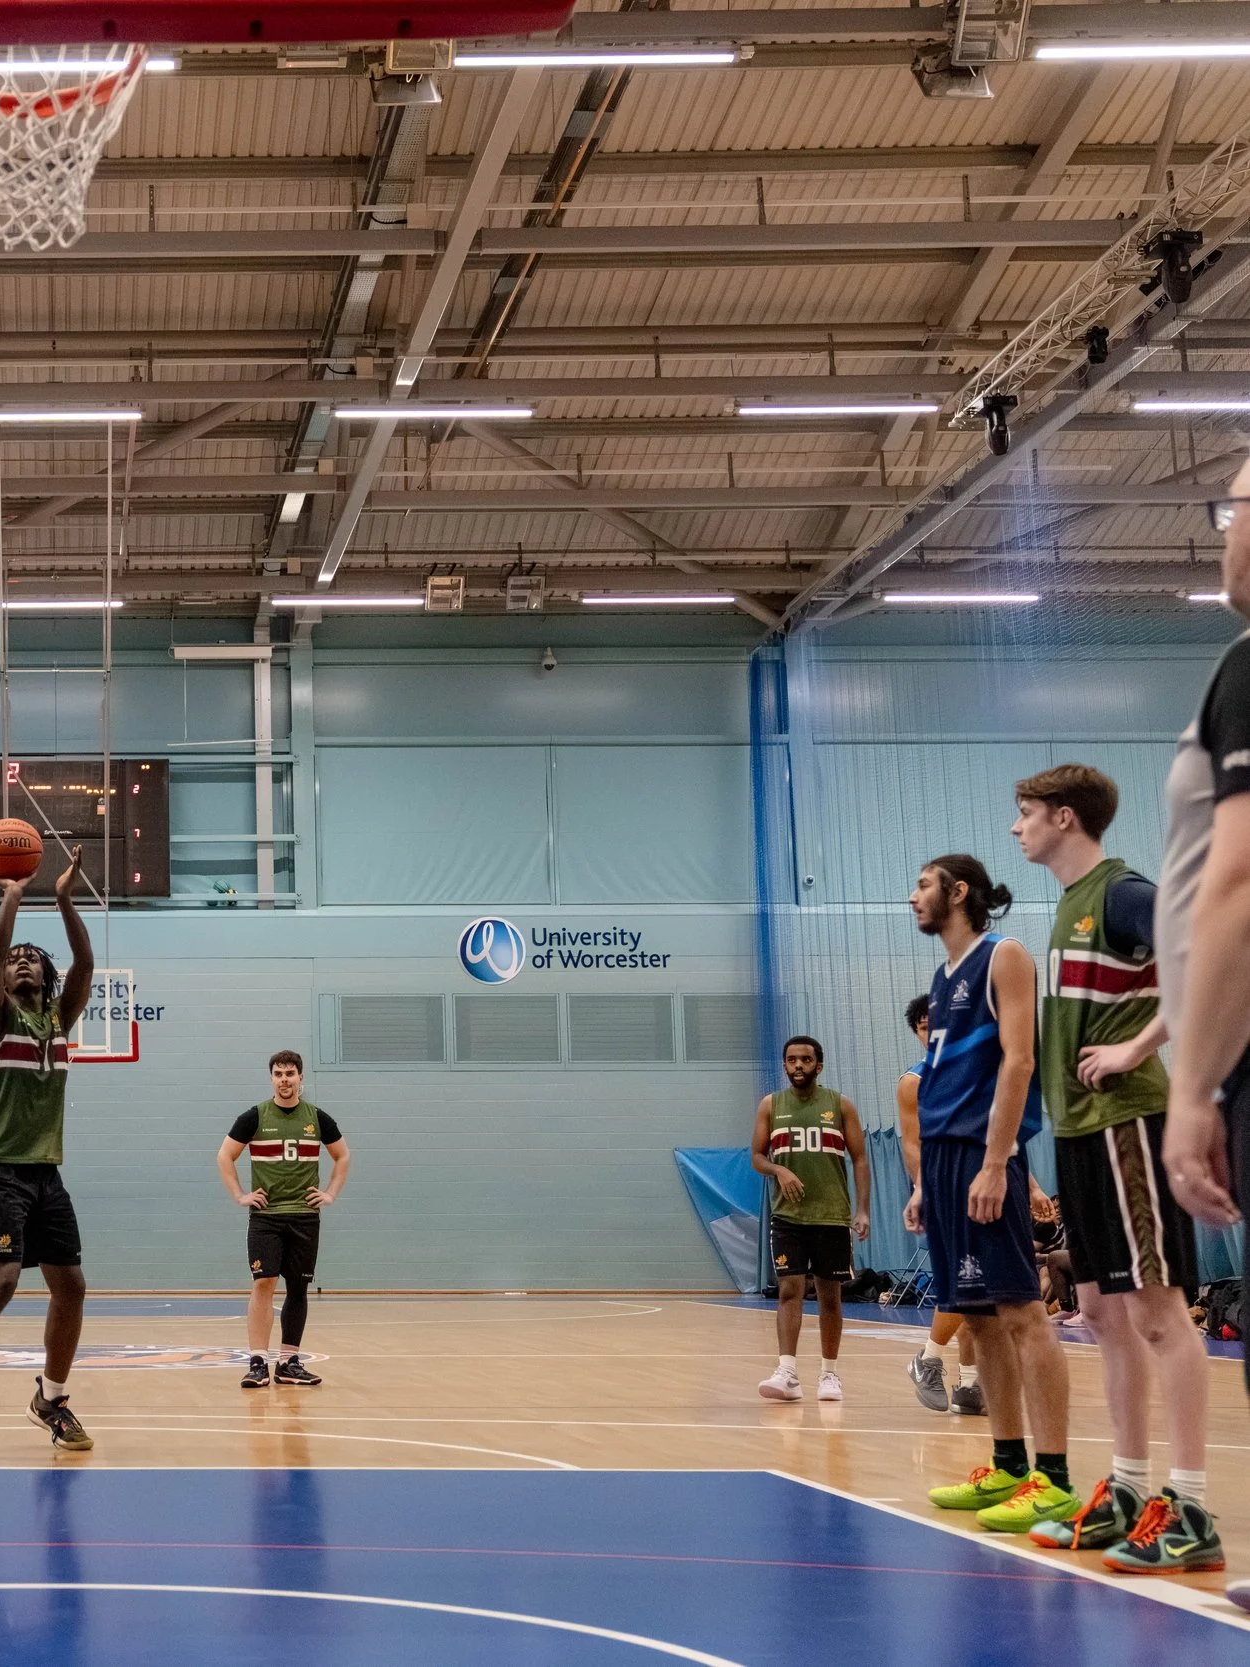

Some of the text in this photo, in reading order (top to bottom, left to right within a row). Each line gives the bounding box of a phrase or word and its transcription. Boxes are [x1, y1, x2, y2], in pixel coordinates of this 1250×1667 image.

[7, 763, 19, 783] 2
[133, 784, 140, 794] 2
[134, 828, 141, 838] 7
[134, 872, 141, 883] 3
[531, 926, 642, 953] University
[531, 949, 671, 969] of Worcester
[82, 1003, 165, 1021] orcester
[929, 1028, 948, 1069] 7
[790, 1126, 822, 1153] 30
[283, 1139, 298, 1161] 6
